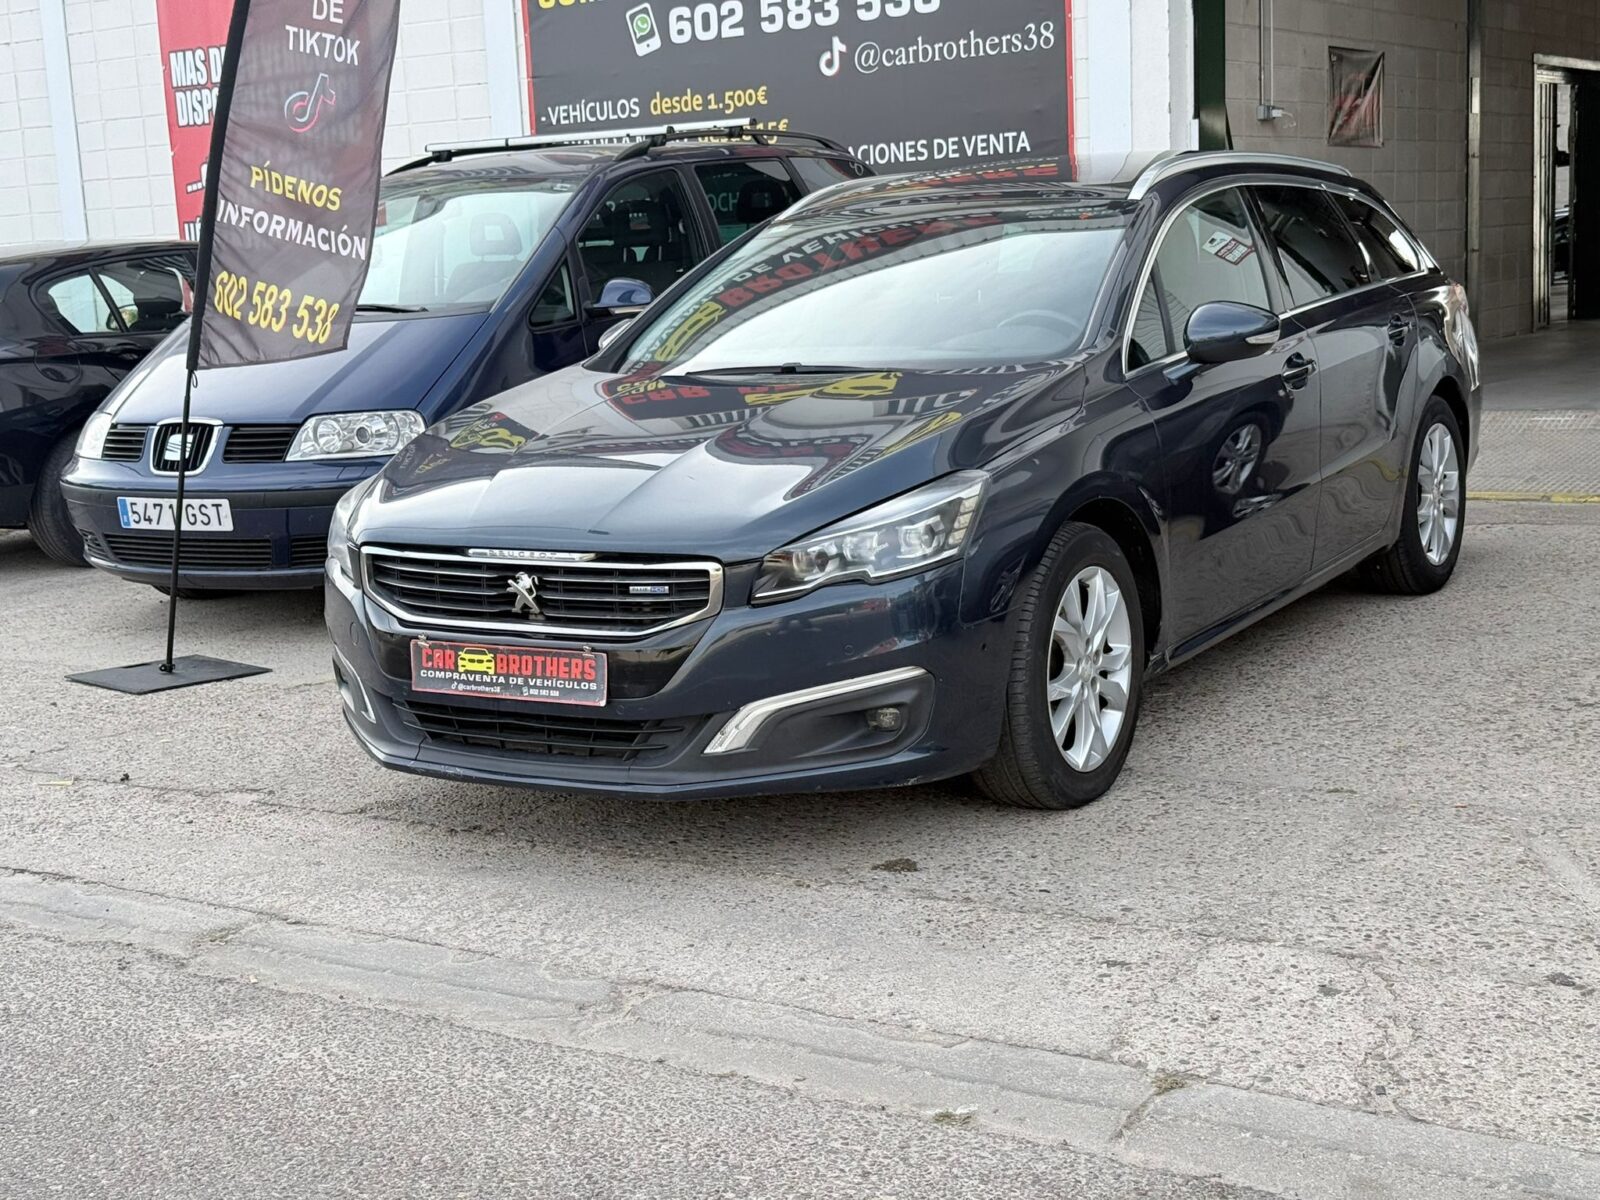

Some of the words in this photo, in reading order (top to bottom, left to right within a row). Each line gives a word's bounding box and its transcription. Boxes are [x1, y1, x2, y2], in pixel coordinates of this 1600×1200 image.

[312, 0, 343, 24] DE
[669, 1, 744, 44] 602
[760, 0, 839, 33] 583
[285, 25, 360, 66] TIKTOK
[854, 21, 1055, 74] @carbrothers38
[169, 48, 208, 88] MAS
[208, 46, 226, 84] D
[548, 98, 640, 125] VEHÍCULOS
[650, 88, 703, 115] desde
[707, 86, 768, 114] 1.500€
[933, 137, 959, 160] DE
[962, 131, 1031, 157] VENTA
[251, 161, 343, 211] PÍDENOS
[217, 200, 366, 261] INFORMACIÓN
[214, 270, 247, 322] 602
[249, 281, 290, 333] 583
[292, 295, 340, 344] 538
[130, 502, 177, 527] 5471
[185, 503, 223, 526] GST
[420, 669, 506, 684] COMPRAVENTA
[510, 676, 524, 686] DE
[528, 677, 598, 690] VEHÍCULOS
[421, 648, 455, 670] CAR
[496, 653, 597, 680] BROTHERS
